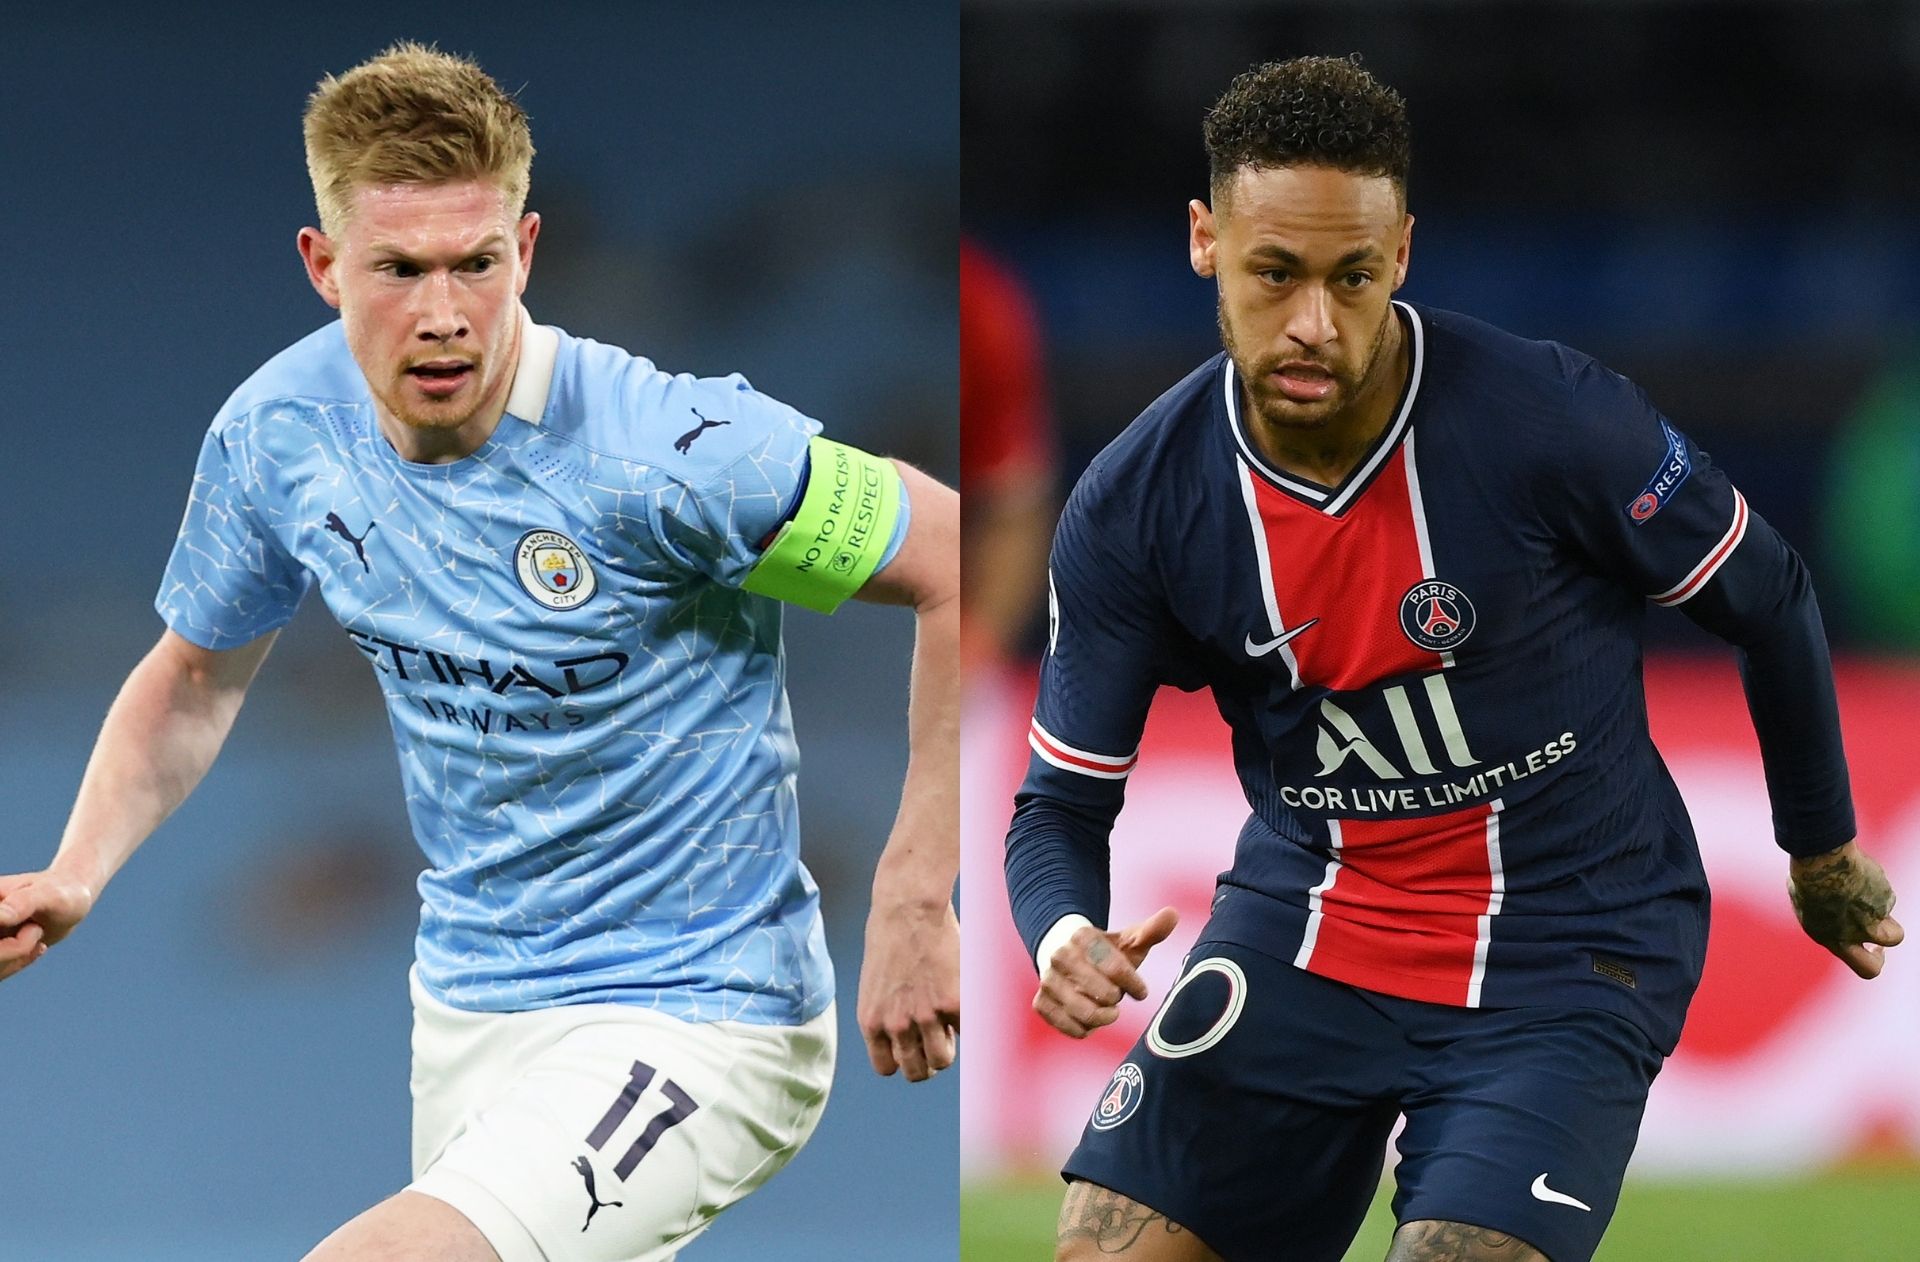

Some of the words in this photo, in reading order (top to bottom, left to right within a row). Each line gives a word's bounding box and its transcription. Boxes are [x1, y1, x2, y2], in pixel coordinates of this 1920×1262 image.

[848, 463, 879, 549] RESPECT
[521, 534, 582, 560] MANCHESTER
[796, 547, 821, 573] NO
[814, 518, 836, 544] TO
[552, 595, 577, 605] CITY
[1409, 585, 1457, 605] PARIS
[403, 693, 585, 735] IRWAYS
[1280, 786, 1348, 810] COR
[1351, 787, 1421, 812] LIVE
[1423, 731, 1577, 808] LIMITLESS
[584, 1059, 700, 1183] 17
